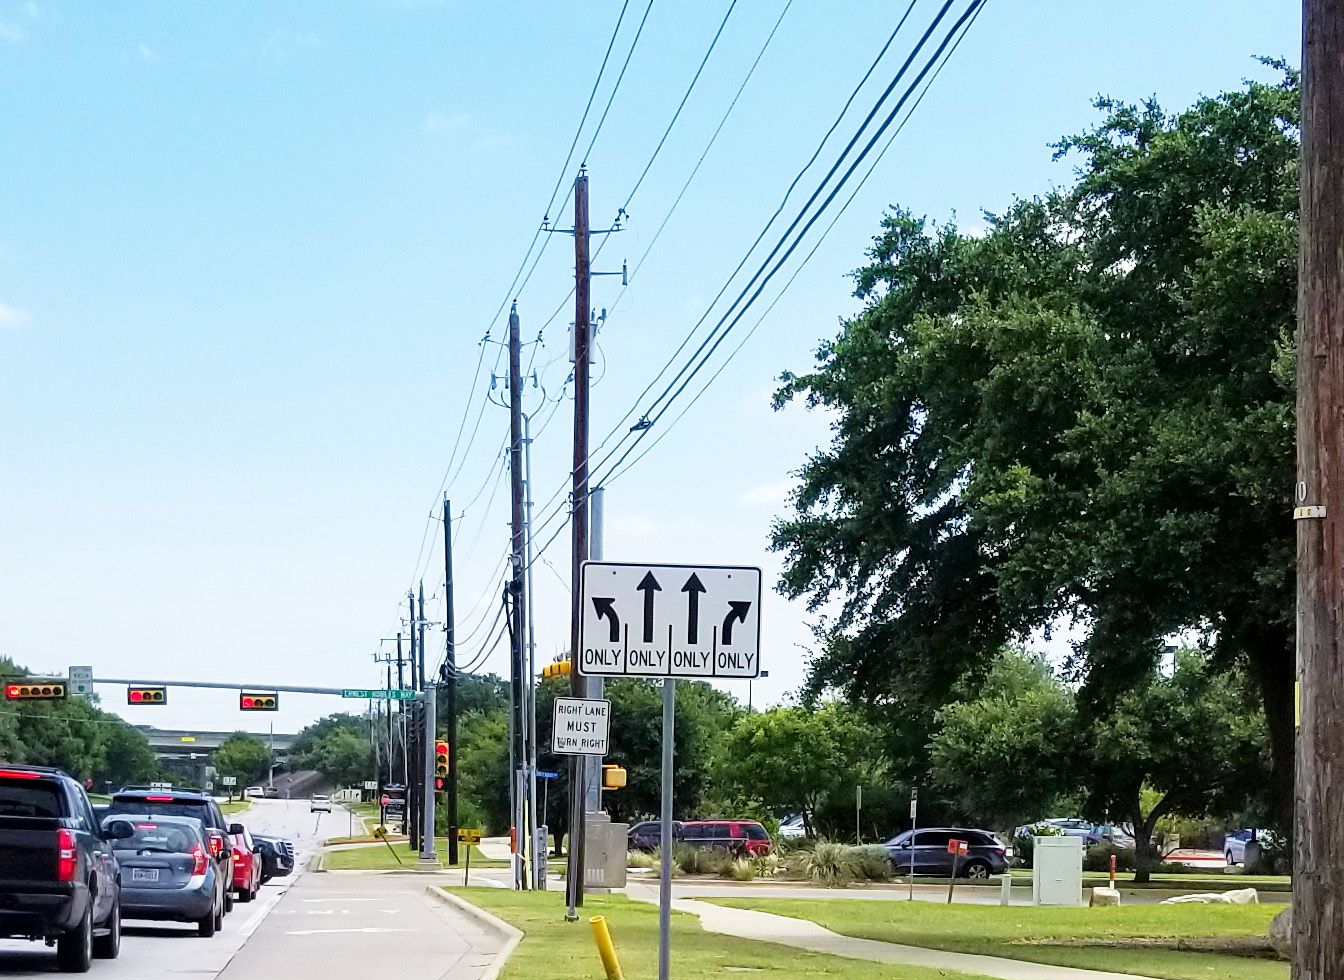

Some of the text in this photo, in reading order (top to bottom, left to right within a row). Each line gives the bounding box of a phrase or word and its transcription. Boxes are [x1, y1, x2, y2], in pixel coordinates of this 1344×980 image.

[585, 648, 755, 670] ONLY ONLY ONLY ONLY
[558, 705, 606, 716] RIGHT LANE
[567, 720, 597, 732] MUST
[581, 737, 605, 748] RIGHT
